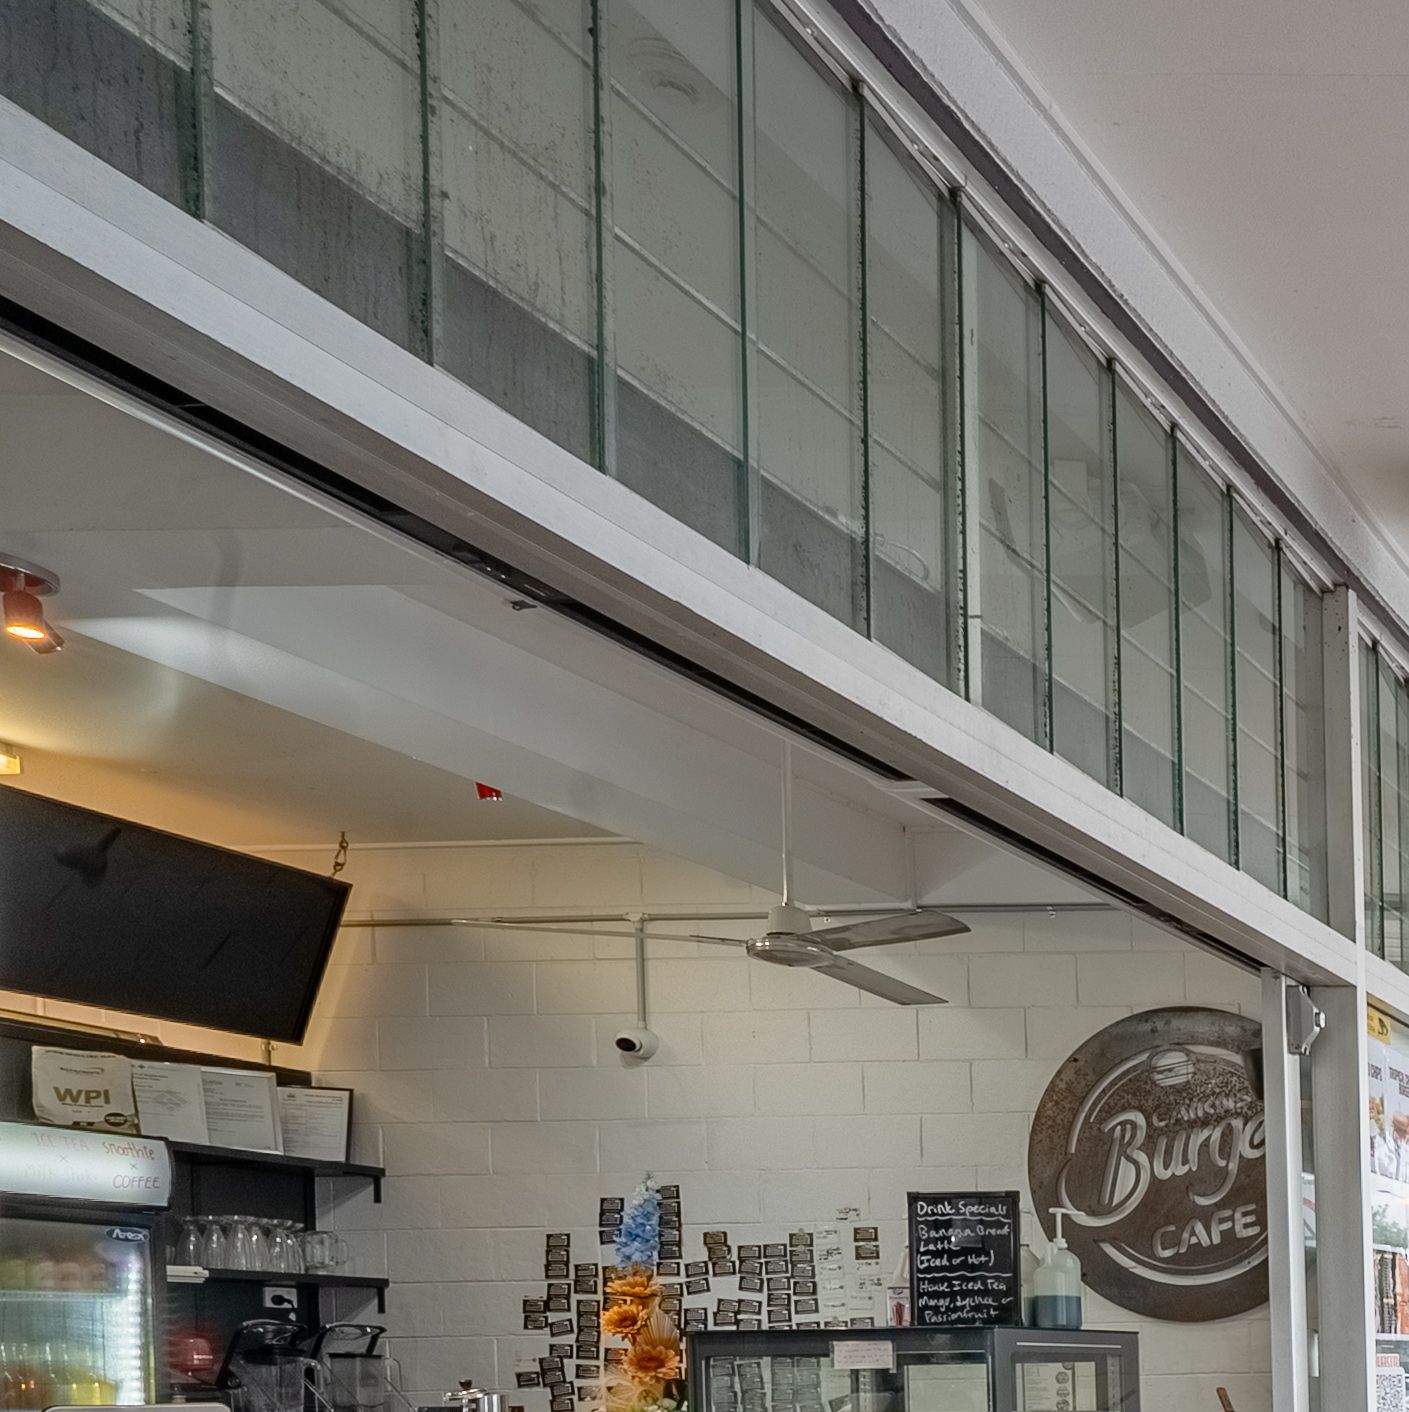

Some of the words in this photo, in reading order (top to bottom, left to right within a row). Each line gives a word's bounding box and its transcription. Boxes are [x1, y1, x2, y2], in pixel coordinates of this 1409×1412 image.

[53, 1086, 111, 1105] WPI
[1152, 1095, 1252, 1127] CAIRNS
[1058, 1109, 1265, 1228] Burge
[112, 1174, 161, 1190] COFFEE
[916, 1201, 956, 1215] Drink
[958, 1201, 1007, 1217] Specials
[1152, 1203, 1261, 1258] CAFE
[919, 1240, 961, 1252] Latte
[951, 1280, 985, 1290] Iced
[986, 1279, 1007, 1291] Tea
